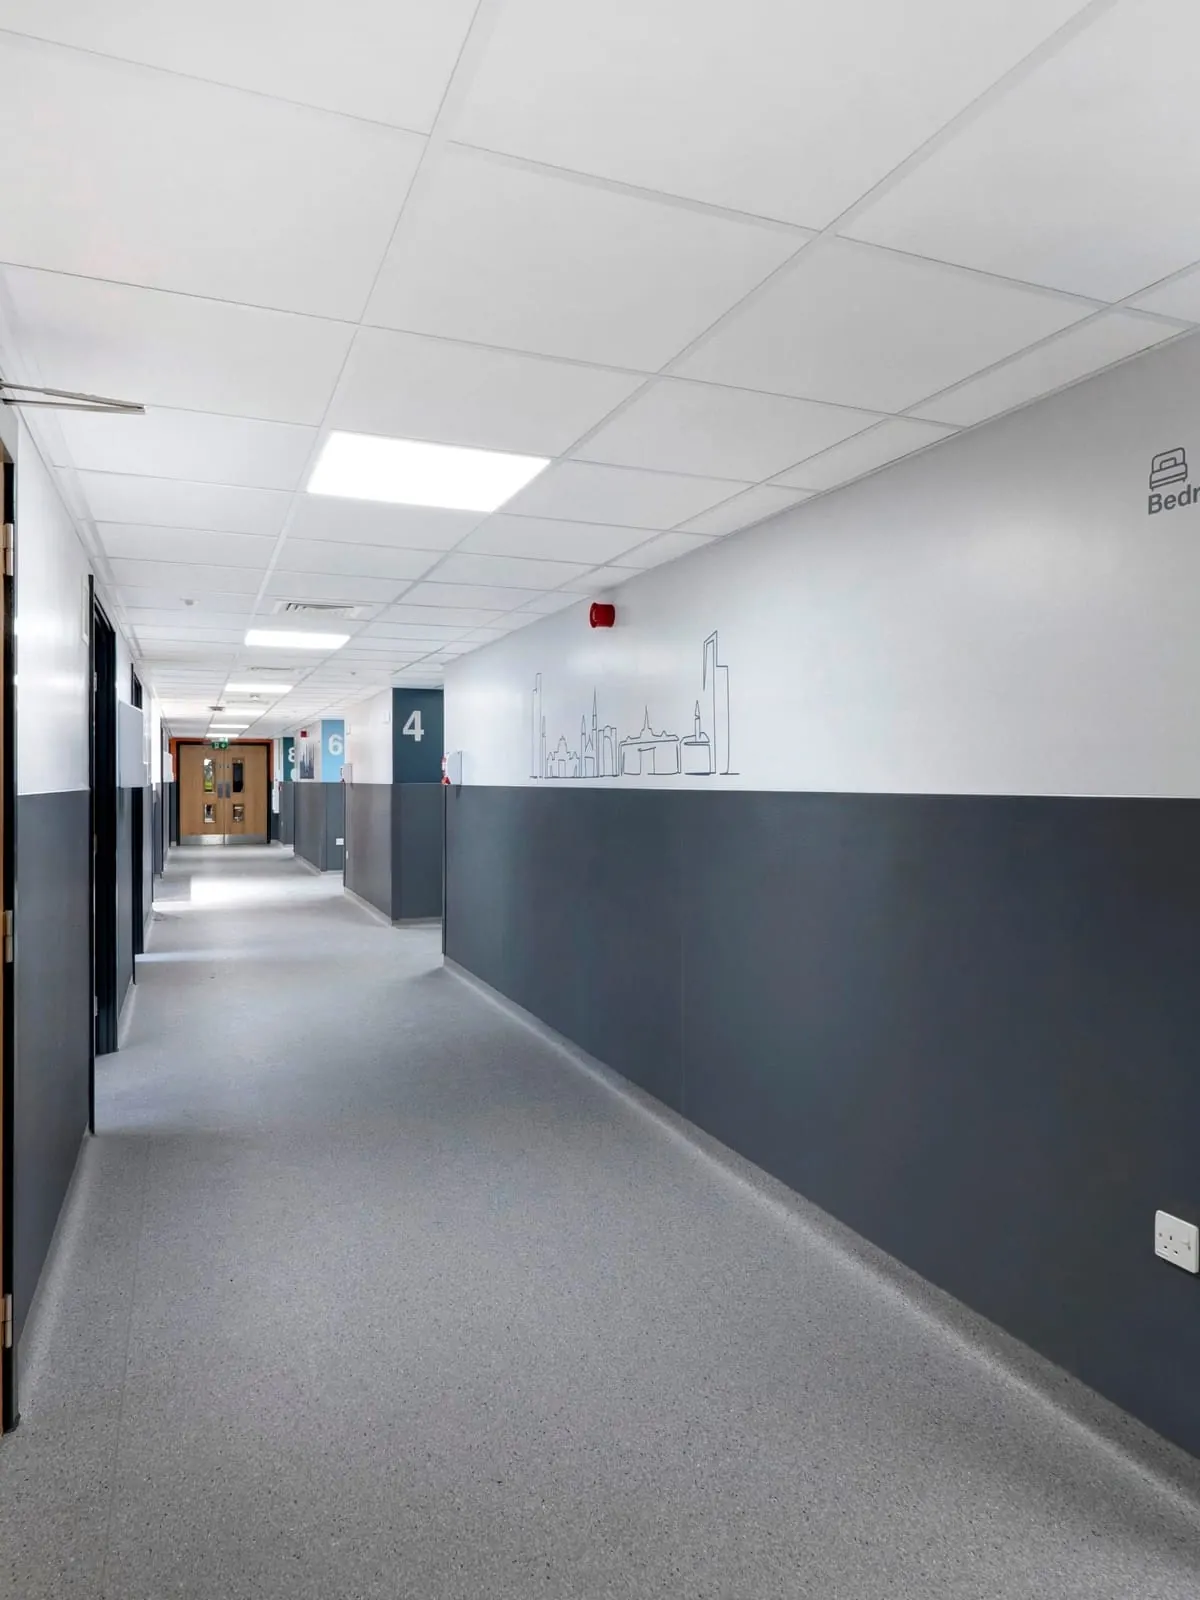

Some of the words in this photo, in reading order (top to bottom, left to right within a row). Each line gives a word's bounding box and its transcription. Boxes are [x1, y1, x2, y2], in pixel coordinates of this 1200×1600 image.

[1148, 484, 1200, 515] Bedr
[402, 710, 425, 742] 4
[328, 734, 343, 755] 6
